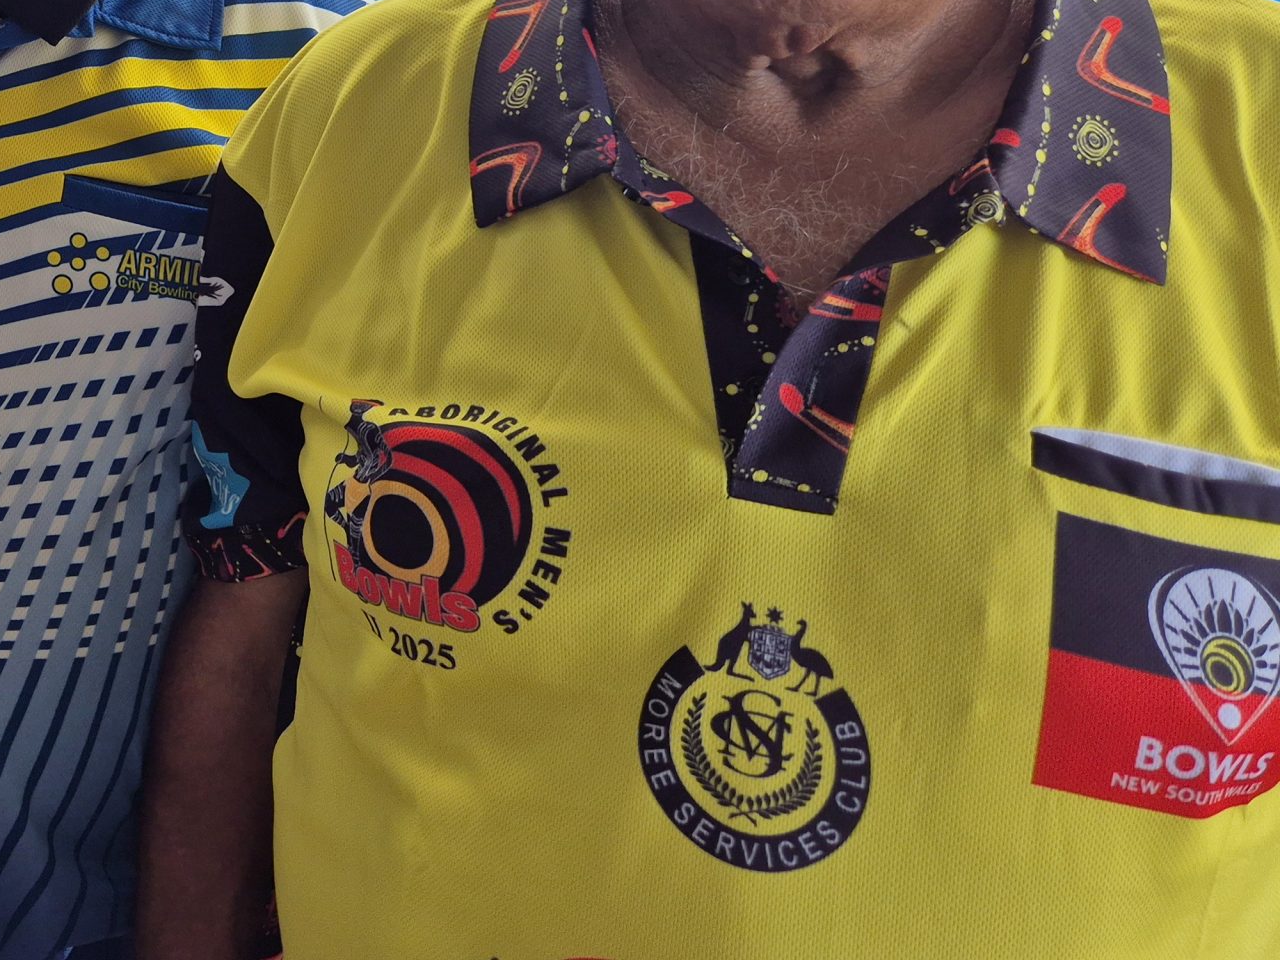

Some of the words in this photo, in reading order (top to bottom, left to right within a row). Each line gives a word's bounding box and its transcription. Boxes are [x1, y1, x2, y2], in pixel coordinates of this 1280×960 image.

[118, 274, 144, 294] City
[388, 403, 569, 509] ABORIGINAL
[493, 526, 572, 635] MEN'S
[389, 626, 456, 670] 2025
[643, 672, 683, 790] MOREE
[673, 801, 841, 868] SERVICES
[834, 720, 867, 814] CLUB
[1134, 735, 1275, 785] BOWLS
[1110, 772, 1160, 795] NEW
[1165, 785, 1224, 806] SOUTH
[1224, 782, 1262, 799] WALES
